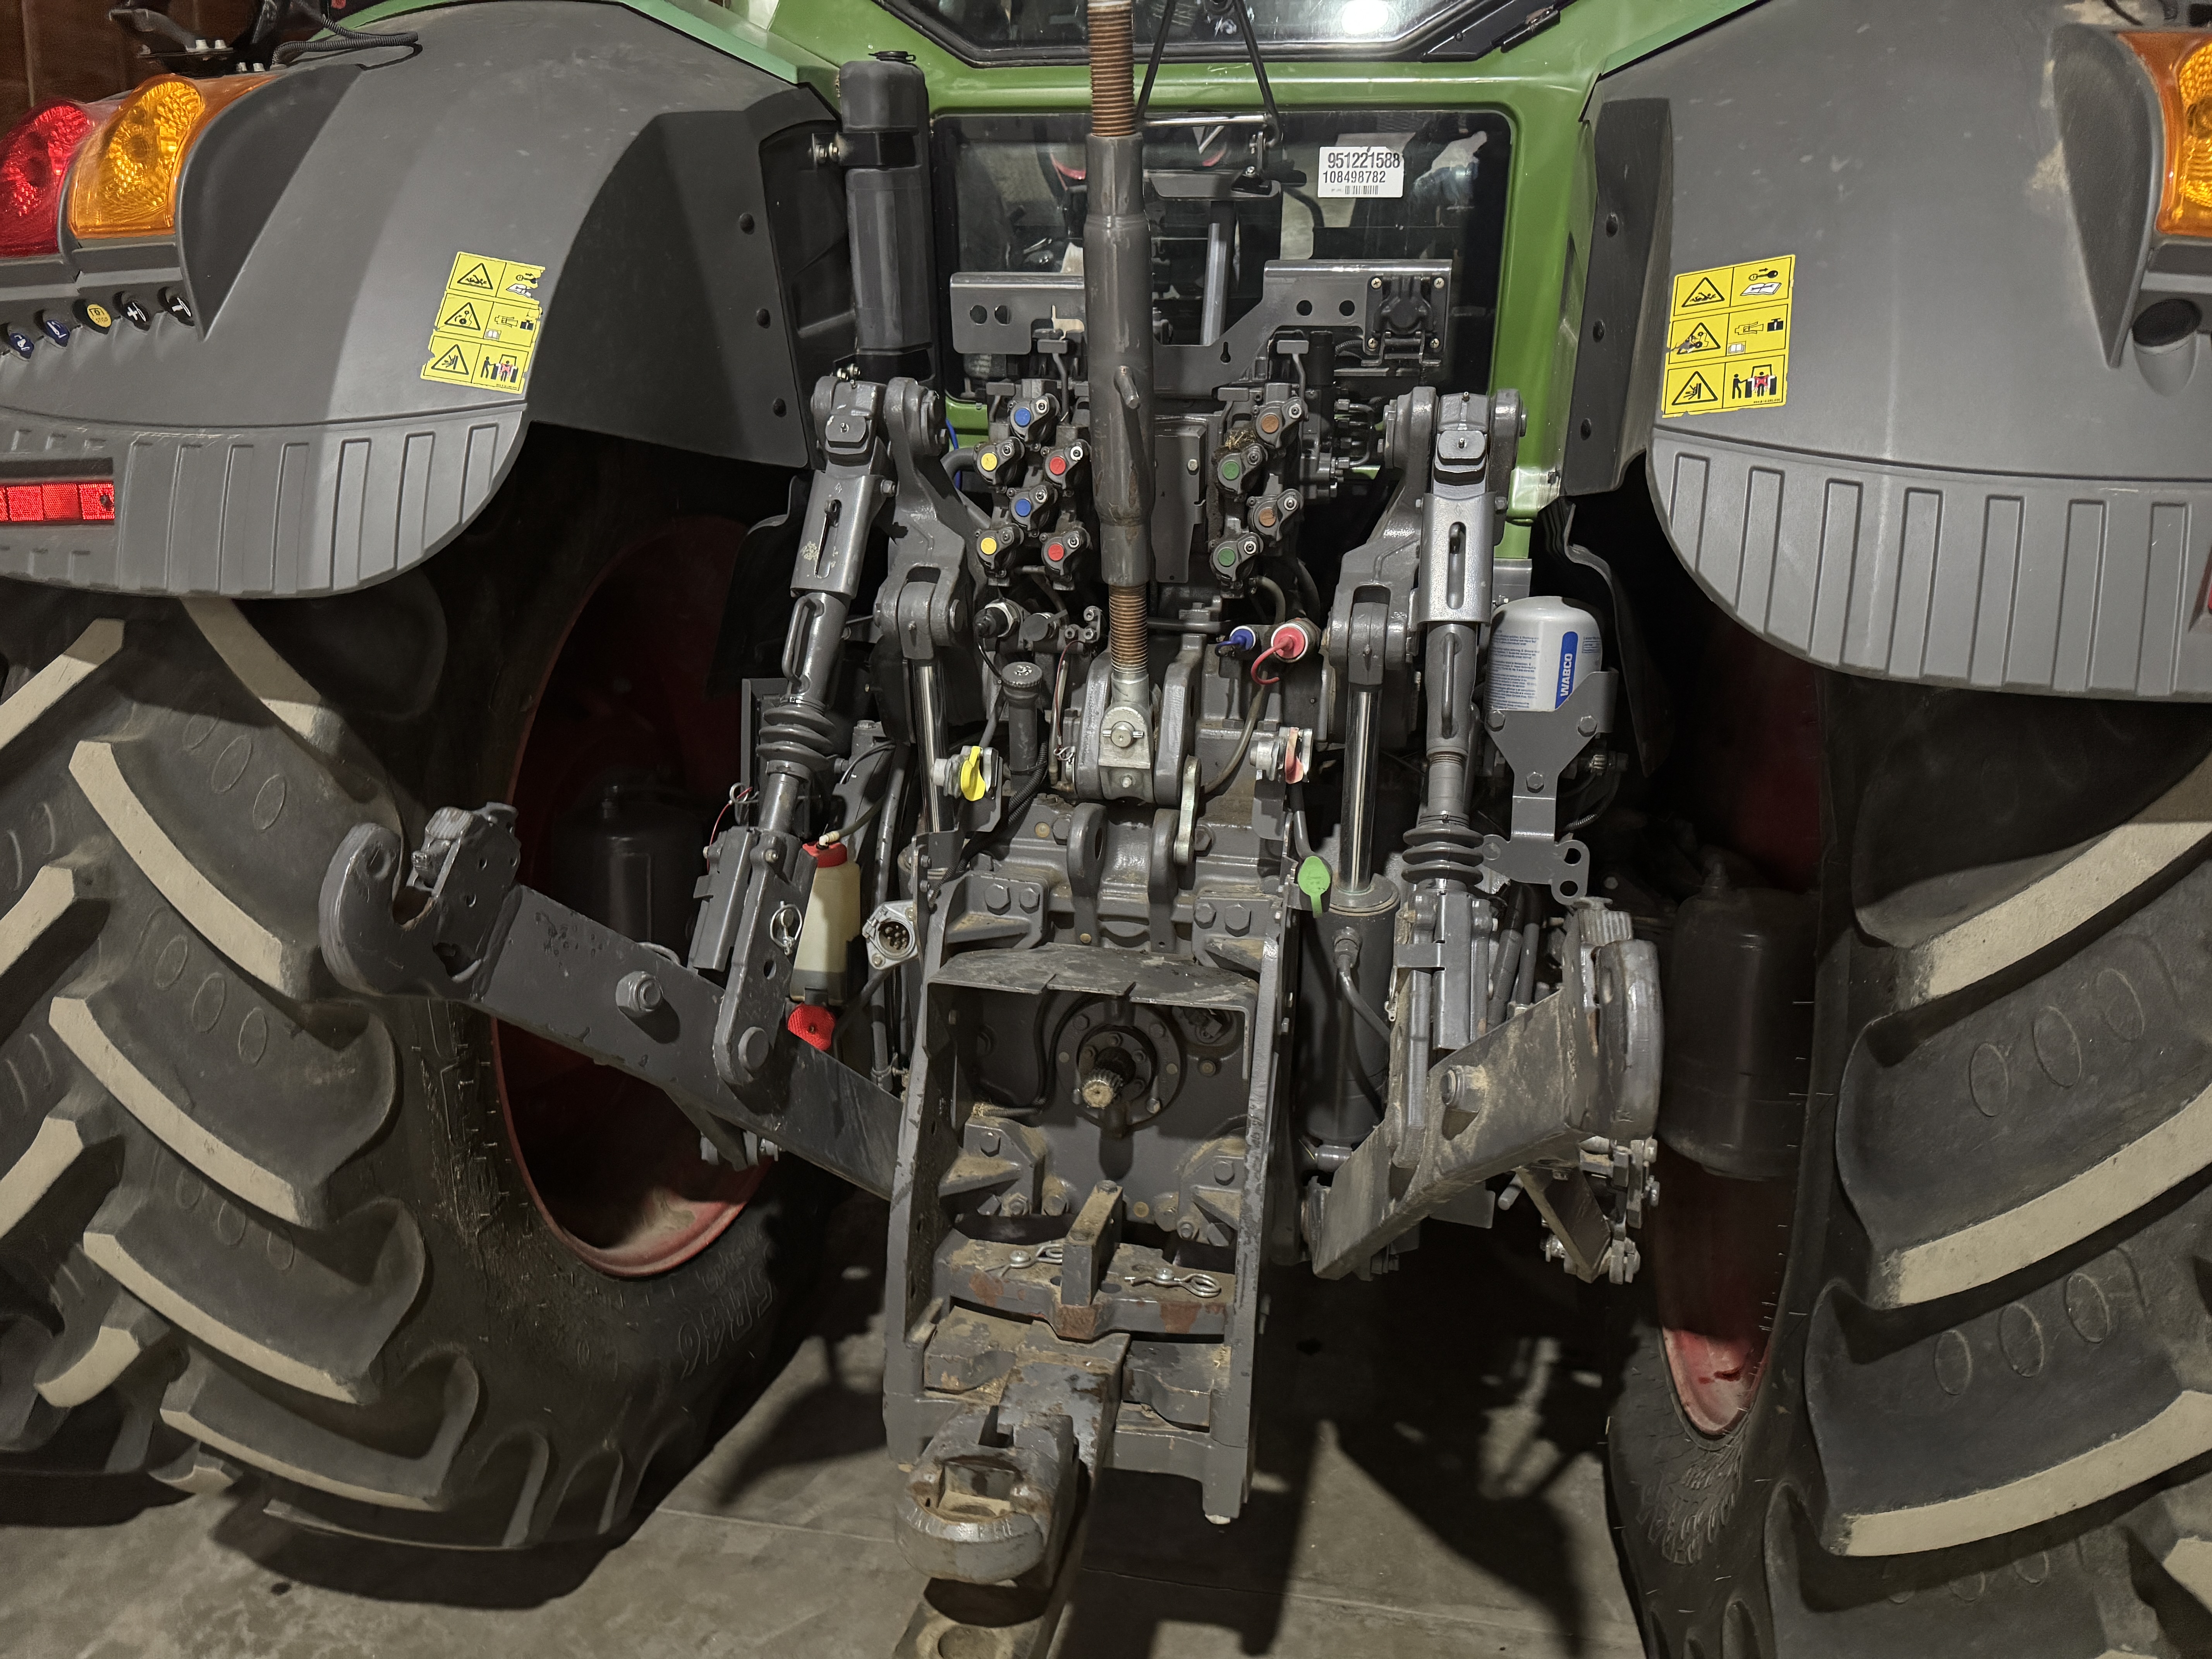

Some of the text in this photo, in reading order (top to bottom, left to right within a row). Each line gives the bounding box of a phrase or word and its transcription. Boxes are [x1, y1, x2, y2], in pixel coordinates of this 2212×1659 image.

[1328, 152, 1400, 168] 951221588
[1323, 170, 1386, 183] 108498782
[1560, 653, 1573, 697] WABCO
